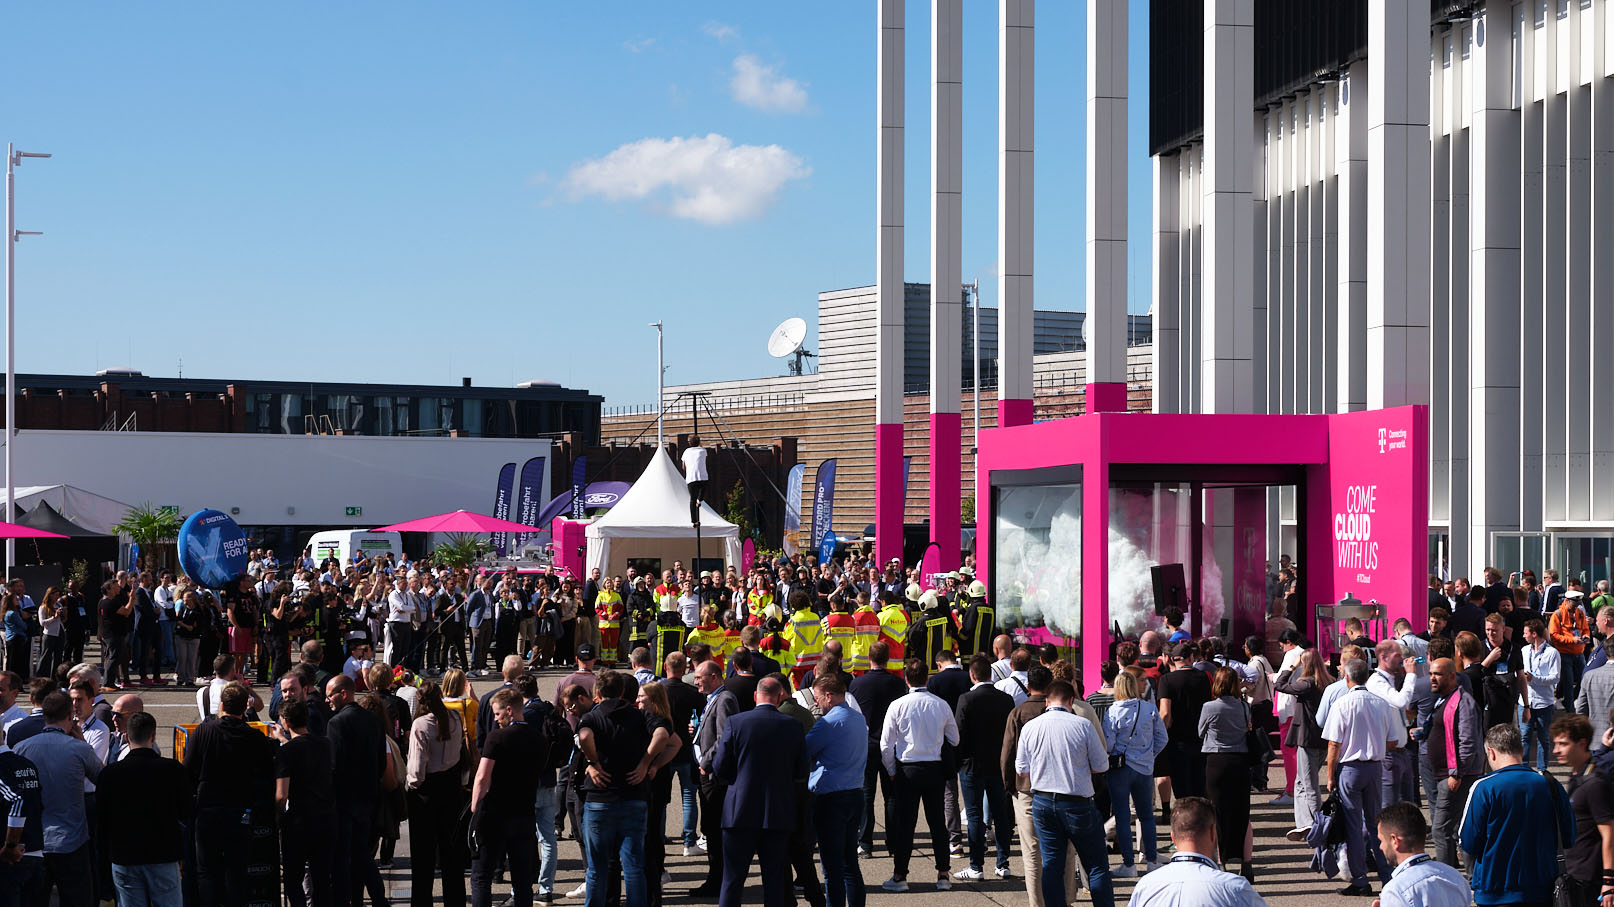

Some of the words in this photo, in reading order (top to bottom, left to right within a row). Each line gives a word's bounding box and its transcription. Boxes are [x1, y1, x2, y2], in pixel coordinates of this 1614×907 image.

[1378, 428, 1386, 454] T
[1346, 485, 1377, 514] COME
[1334, 512, 1371, 541] CLOUD
[225, 548, 241, 558] FOR
[1338, 540, 1362, 569] WITH
[1364, 541, 1378, 570] US
